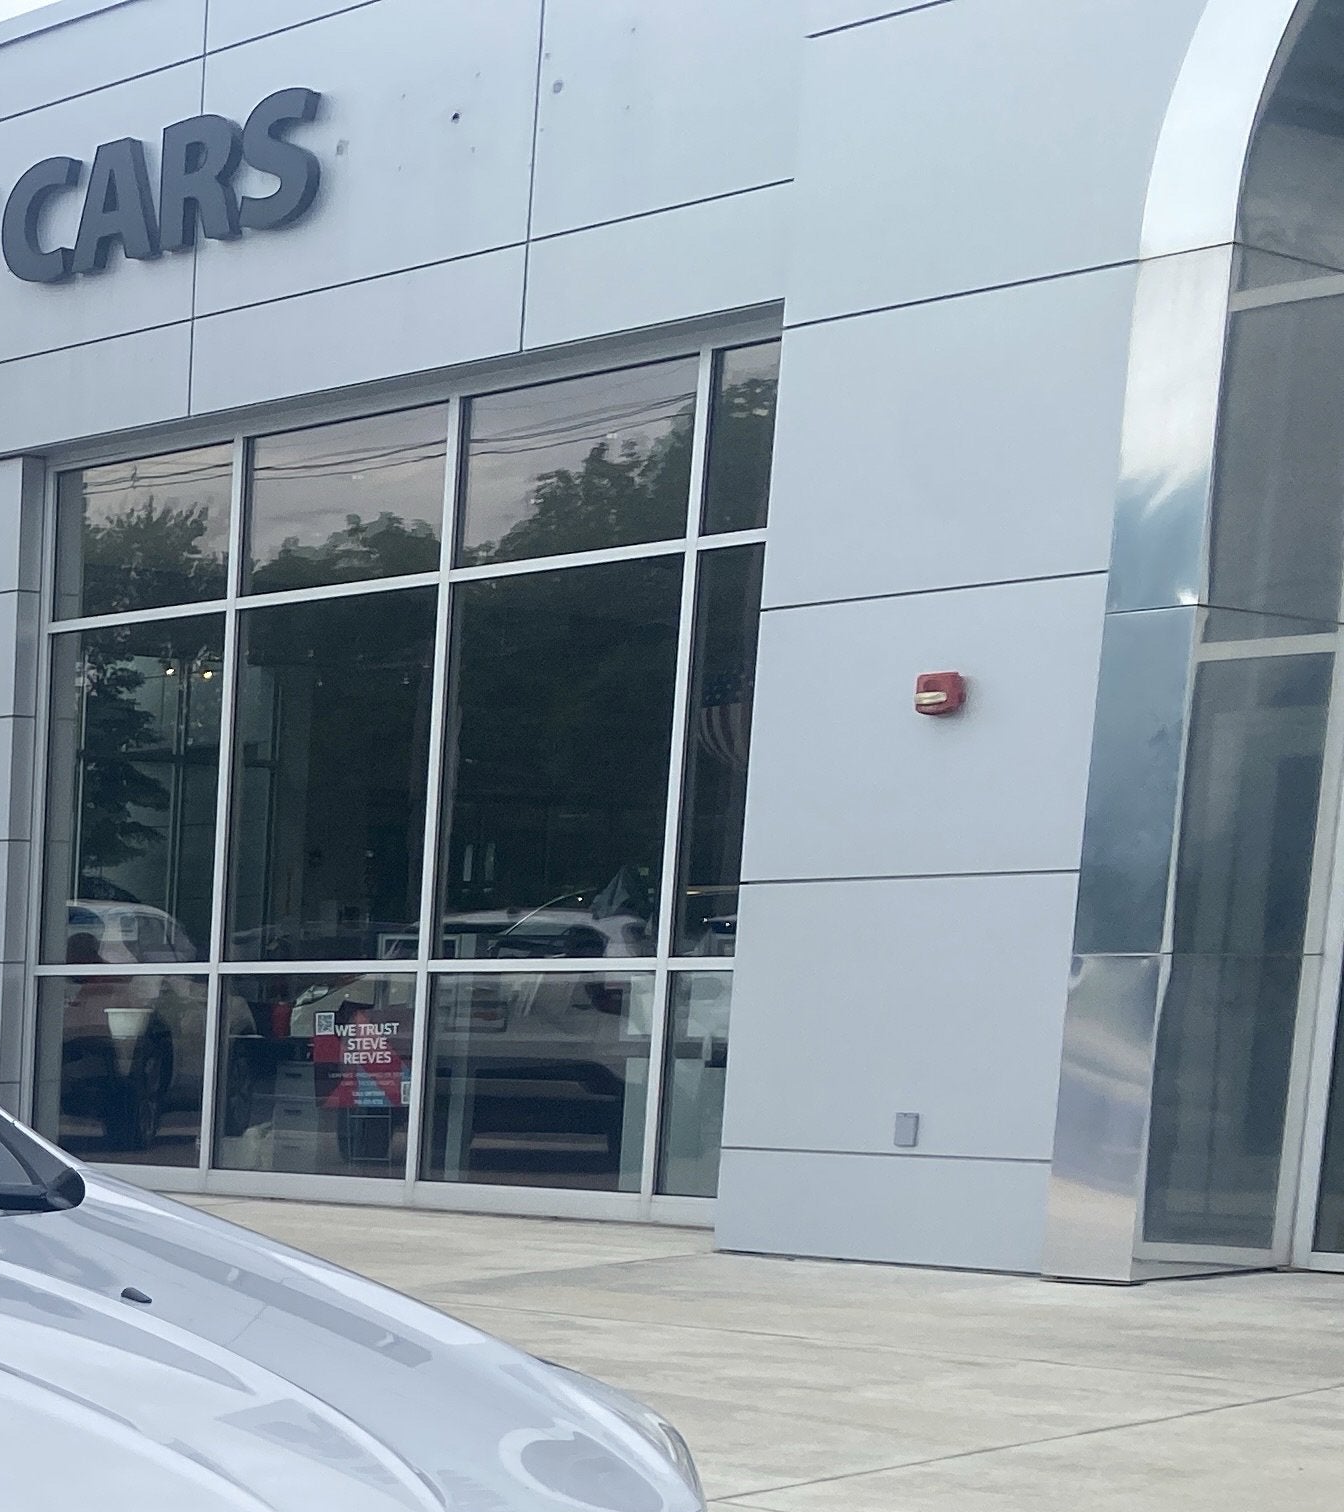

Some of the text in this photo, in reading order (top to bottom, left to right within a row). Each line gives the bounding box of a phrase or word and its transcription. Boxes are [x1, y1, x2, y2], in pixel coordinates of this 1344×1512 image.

[2, 87, 322, 283] CARS
[335, 1022, 399, 1037] WE TRUST
[347, 1037, 388, 1050] STEVE
[344, 1051, 392, 1064] REEVES
